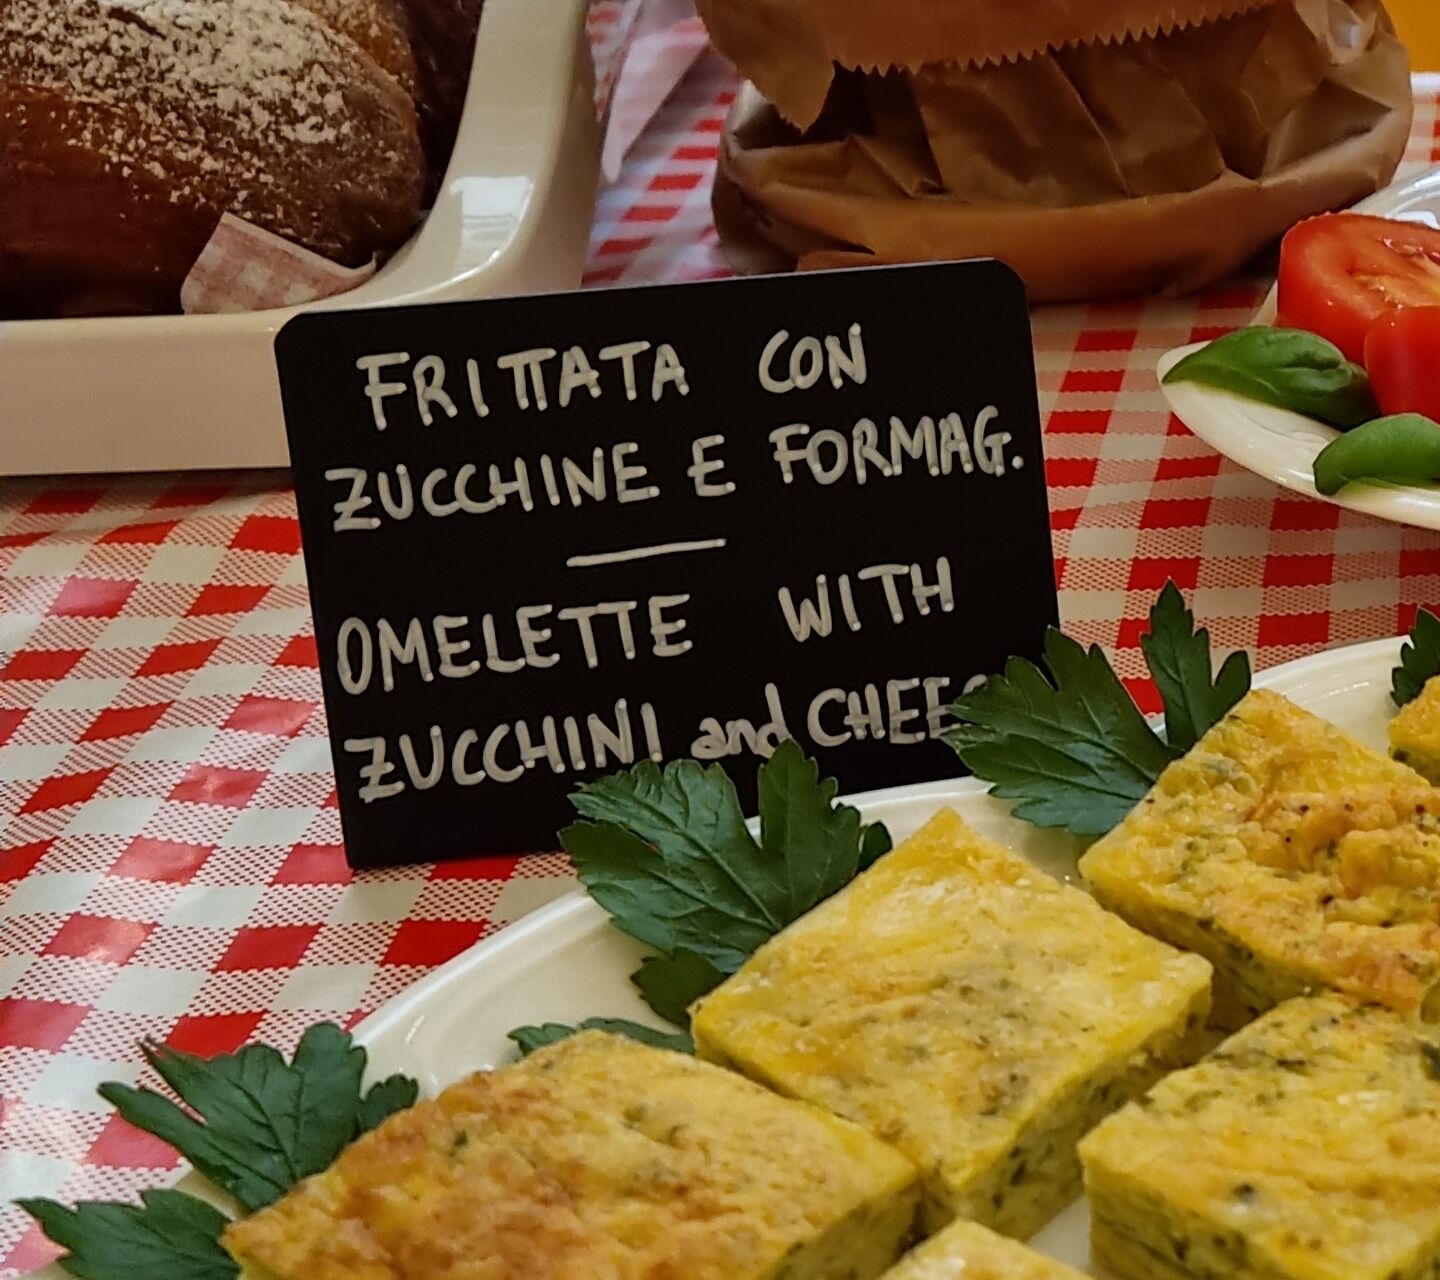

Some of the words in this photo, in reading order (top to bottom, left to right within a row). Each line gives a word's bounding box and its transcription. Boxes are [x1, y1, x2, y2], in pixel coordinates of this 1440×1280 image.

[356, 340, 690, 431] FRITTATA
[758, 322, 867, 393] CON
[325, 442, 660, 531] ZUCCHINE
[687, 434, 736, 497] E
[769, 405, 1023, 485] FORMAG.
[337, 593, 693, 695] OMELETTE
[778, 556, 954, 642] WITH
[344, 698, 663, 806] ZUCCHINI
[691, 682, 793, 759] and
[807, 674, 987, 747] CHEE
